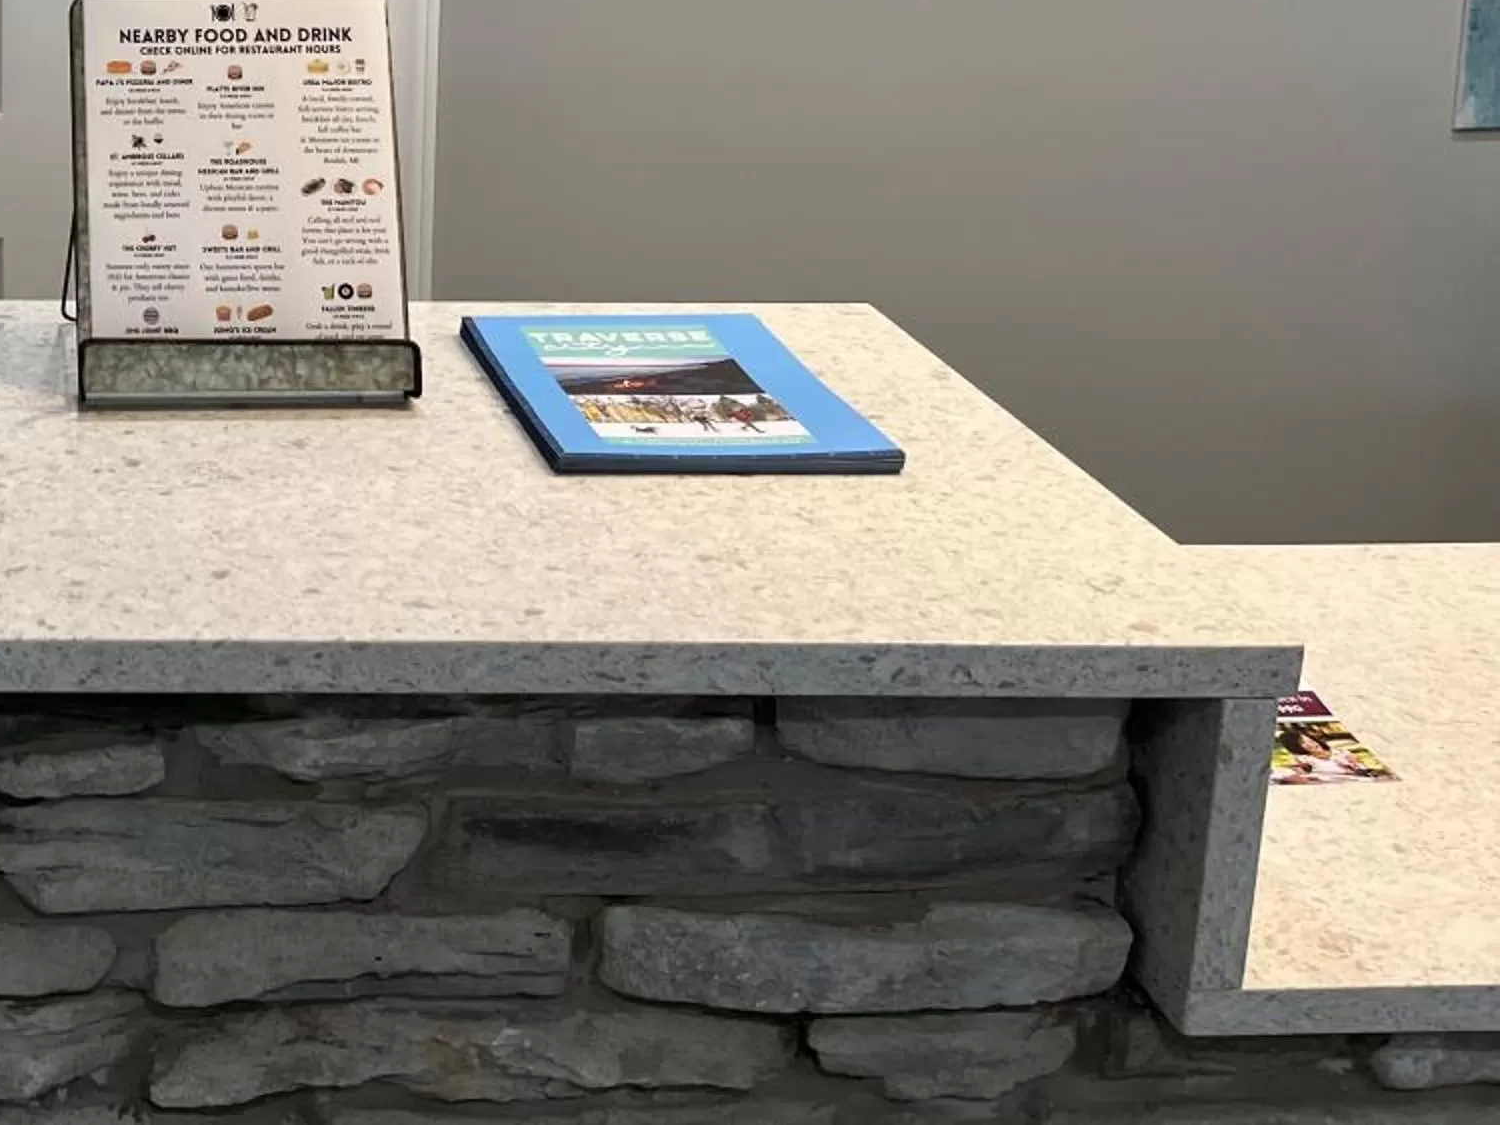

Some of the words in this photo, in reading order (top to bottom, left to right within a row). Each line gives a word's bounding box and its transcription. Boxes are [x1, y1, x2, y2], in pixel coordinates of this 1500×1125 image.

[119, 28, 189, 43] NEARBY
[195, 28, 247, 43] FOOD
[253, 28, 291, 42] AND
[298, 27, 353, 42] DRINK
[140, 46, 171, 55] CHECK
[175, 46, 212, 55] ONLINE
[216, 45, 236, 54] FOR
[239, 45, 302, 54] RESTAURANT
[305, 44, 341, 54] HOURS
[528, 330, 712, 344] TRAVERSE
